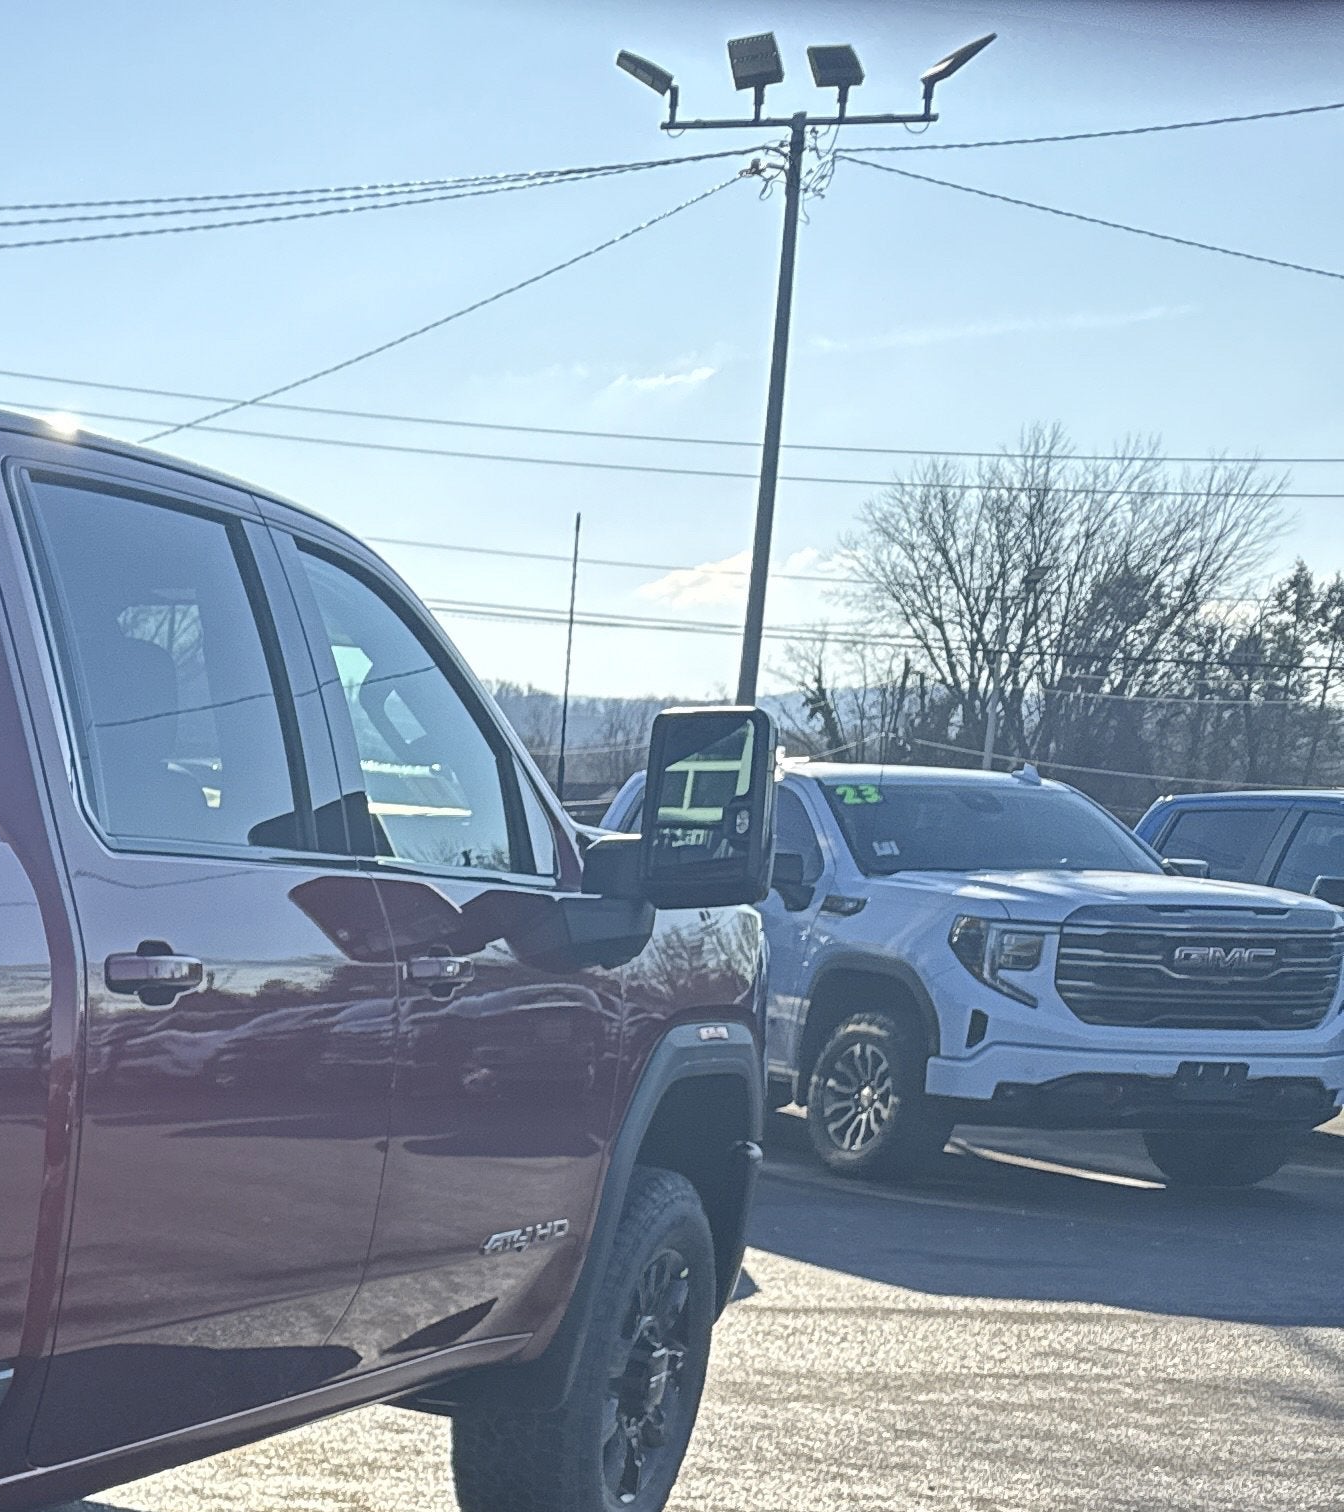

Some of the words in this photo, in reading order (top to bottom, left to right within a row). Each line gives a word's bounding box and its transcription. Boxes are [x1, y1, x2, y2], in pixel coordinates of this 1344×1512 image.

[835, 783, 883, 805] 23
[1173, 946, 1277, 968] GMC
[535, 1218, 569, 1240] HD
